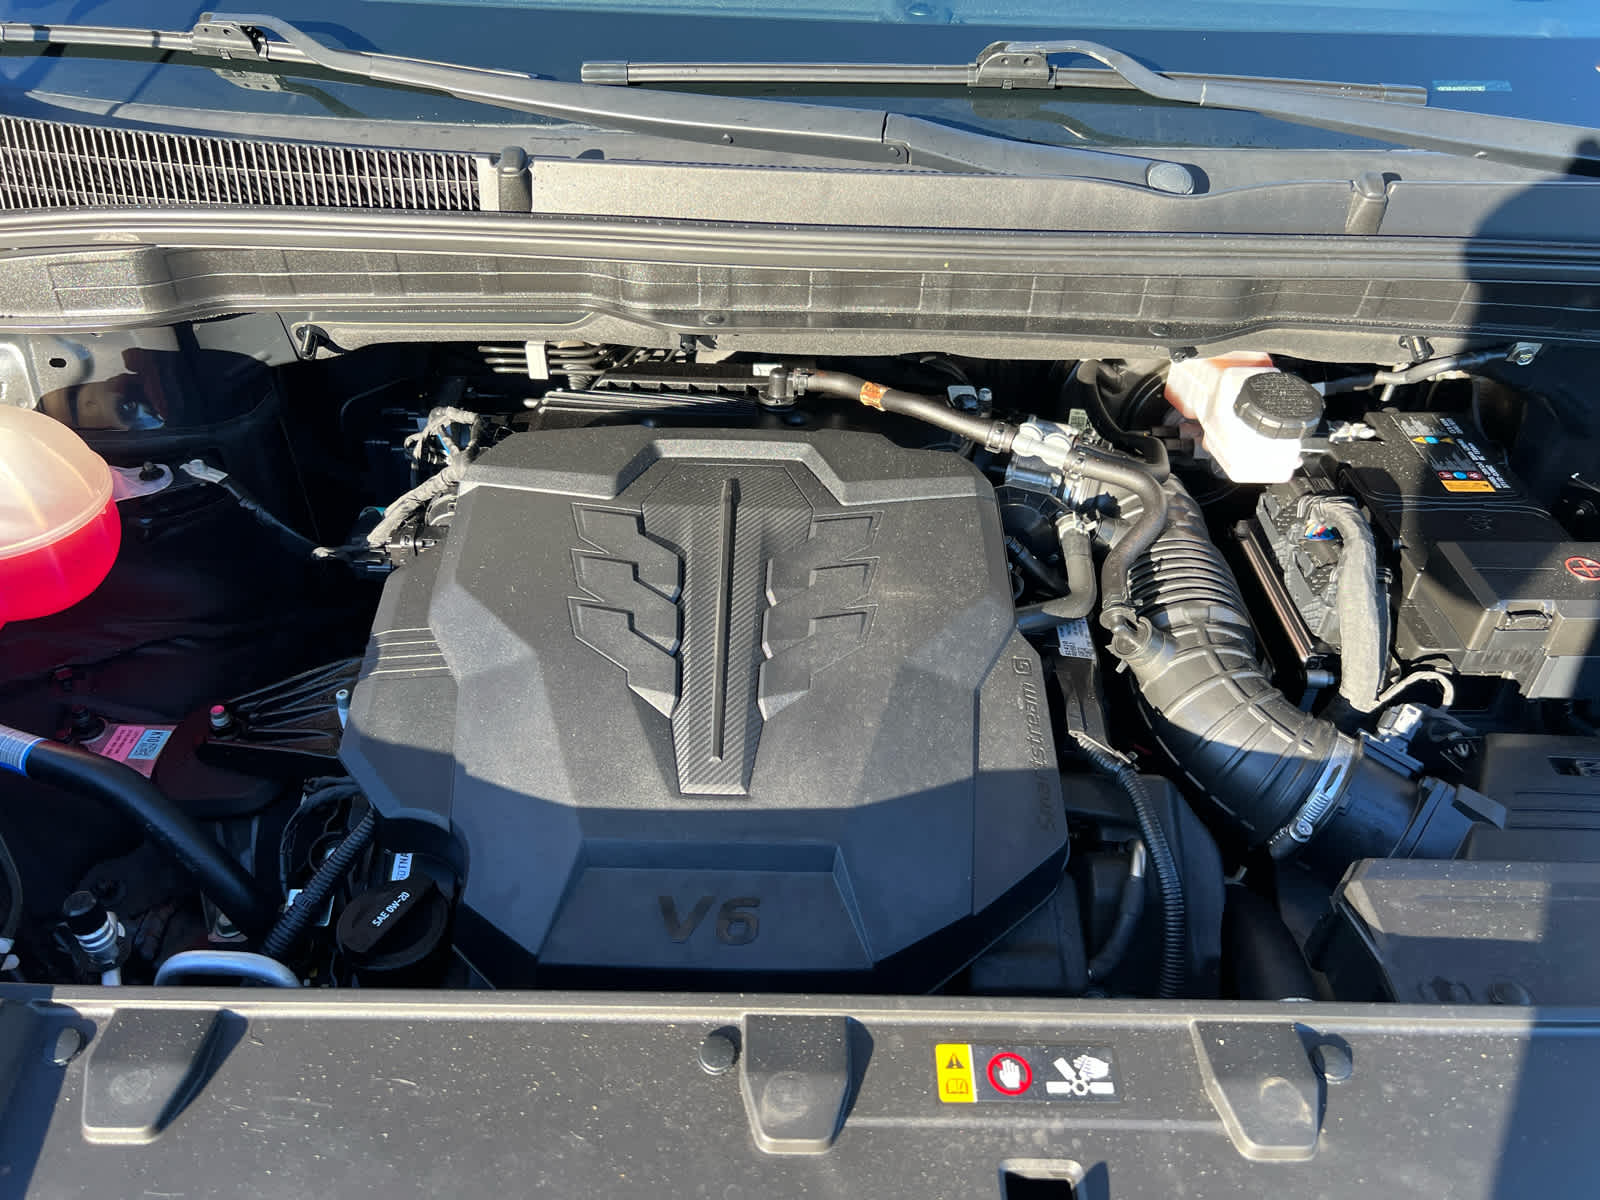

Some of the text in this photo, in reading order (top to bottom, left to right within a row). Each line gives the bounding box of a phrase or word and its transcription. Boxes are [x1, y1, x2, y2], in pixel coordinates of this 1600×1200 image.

[1022, 681, 1056, 832] Smartstream
[372, 891, 410, 927] SAE 0W-20
[658, 896, 761, 944] V6
